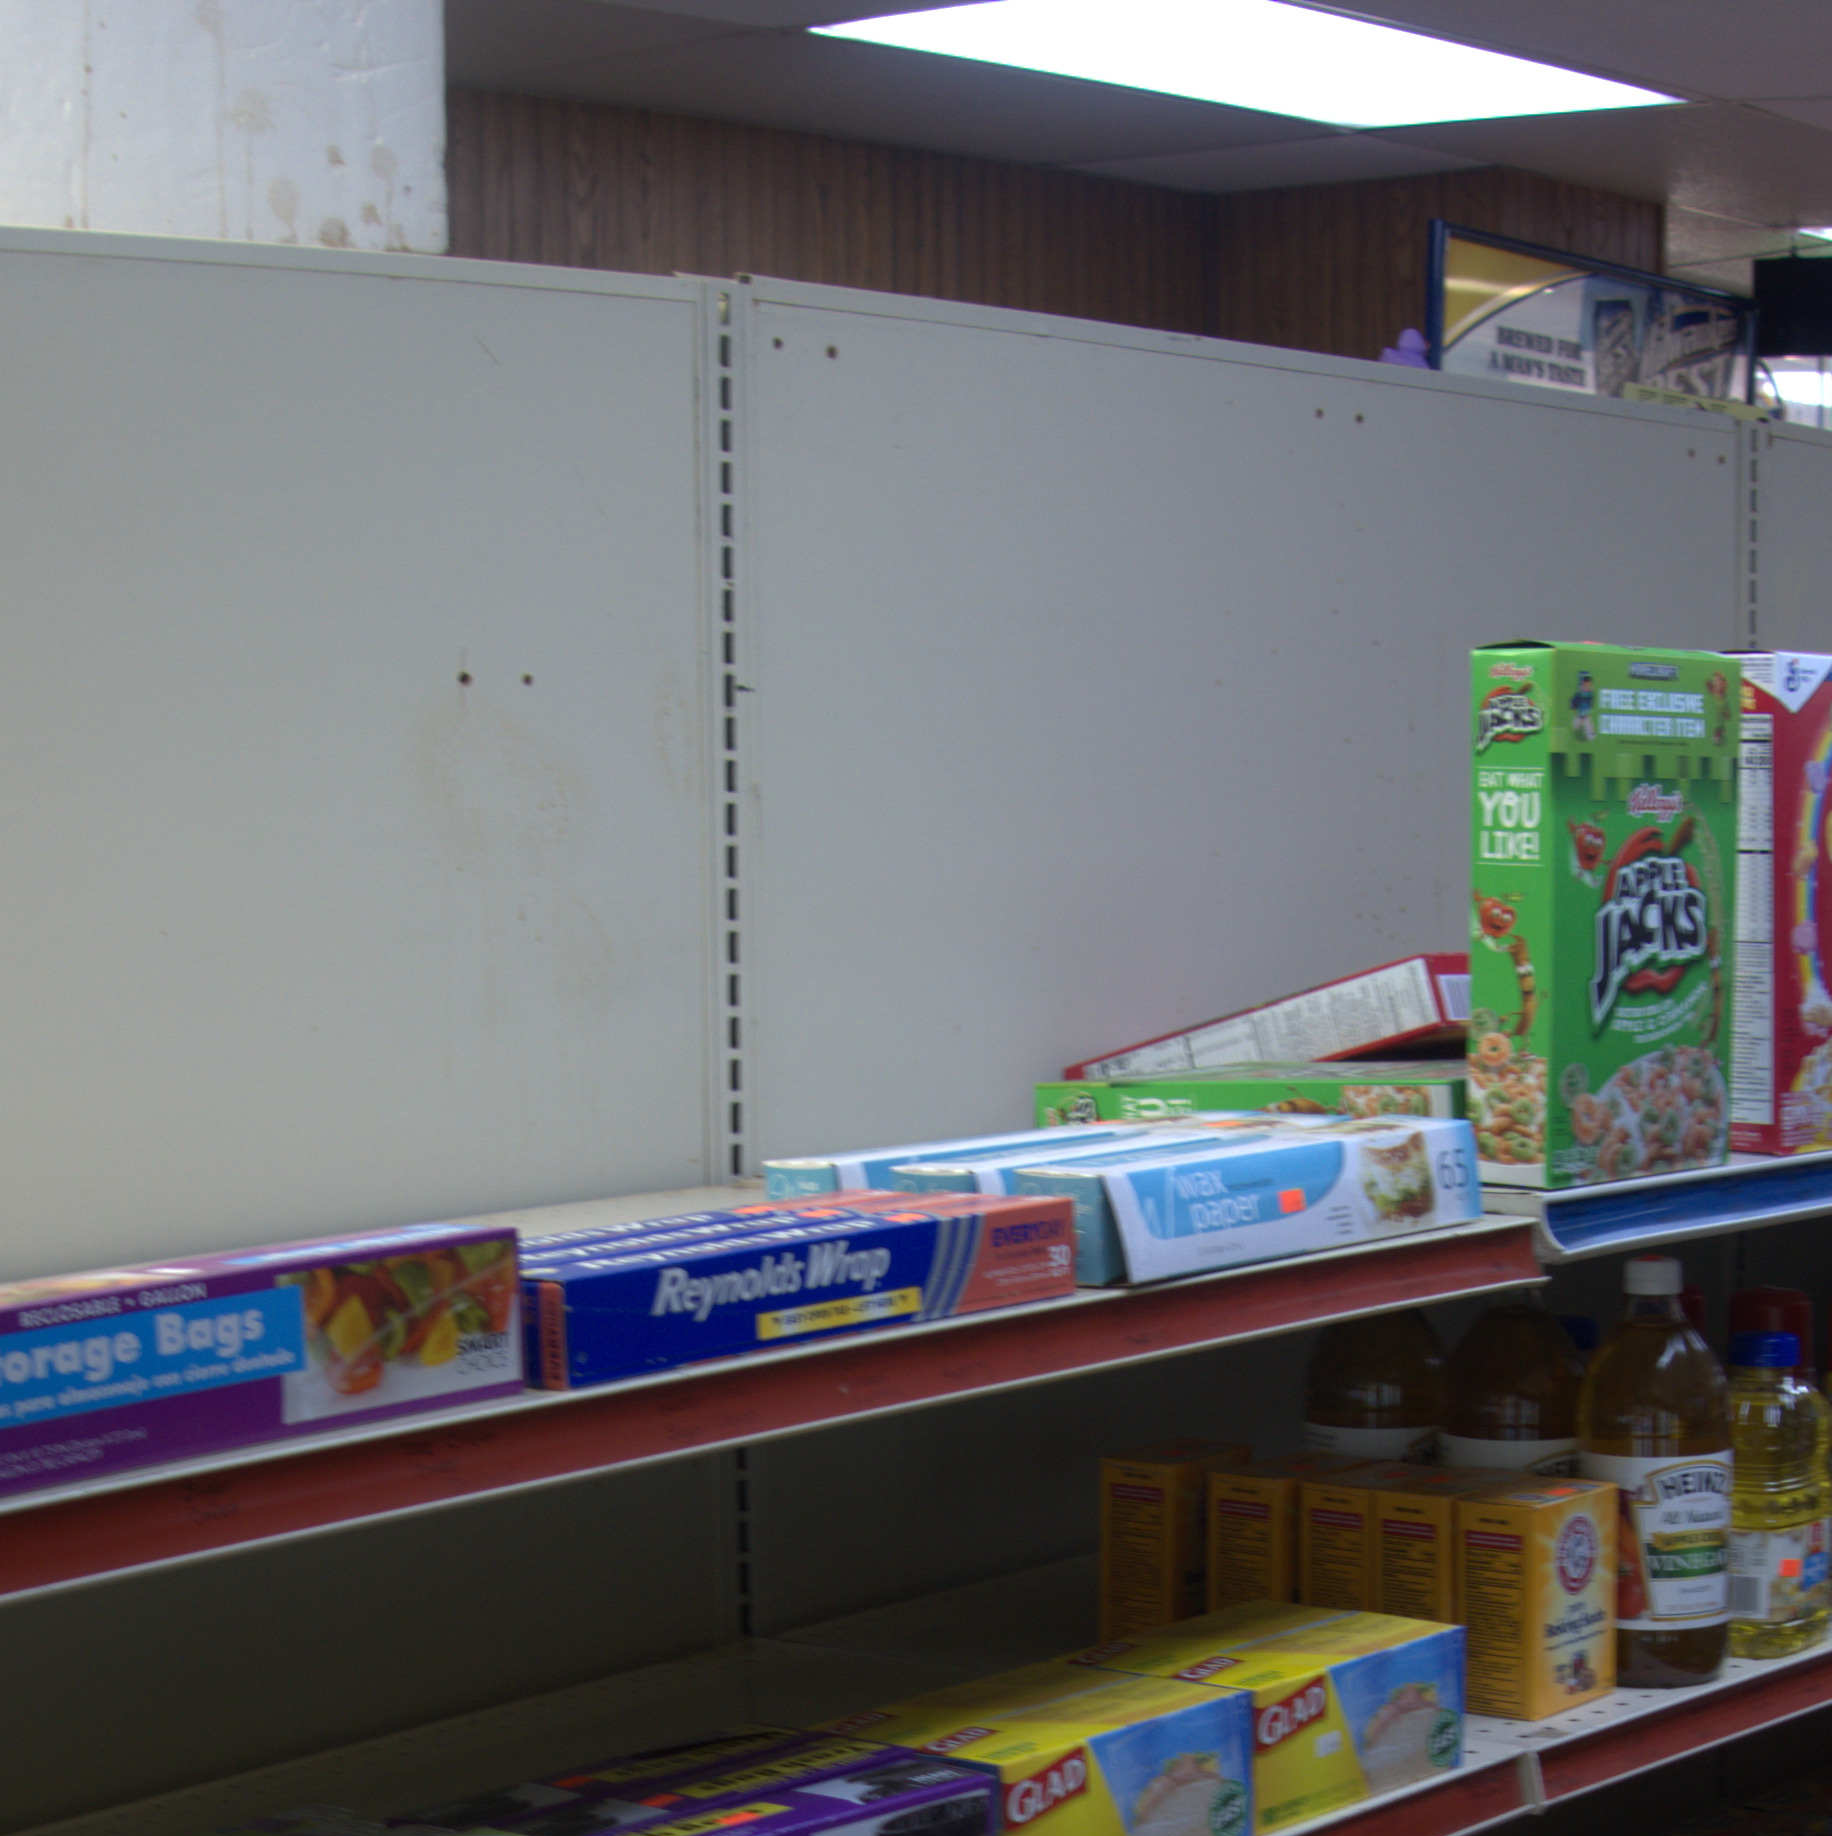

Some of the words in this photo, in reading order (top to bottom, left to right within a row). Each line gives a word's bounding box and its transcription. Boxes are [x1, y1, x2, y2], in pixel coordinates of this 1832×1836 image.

[1478, 790, 1542, 829] YOU
[1591, 888, 1709, 1032] JACKS
[1174, 1169, 1228, 1200] wax
[1188, 1192, 1260, 1234] paper
[649, 1253, 804, 1322] Reynolds
[805, 1240, 891, 1292] Wrap
[153, 1307, 266, 1358] Bags
[1256, 1680, 1325, 1753] GLAD
[1004, 1757, 1086, 1826] GLAD
